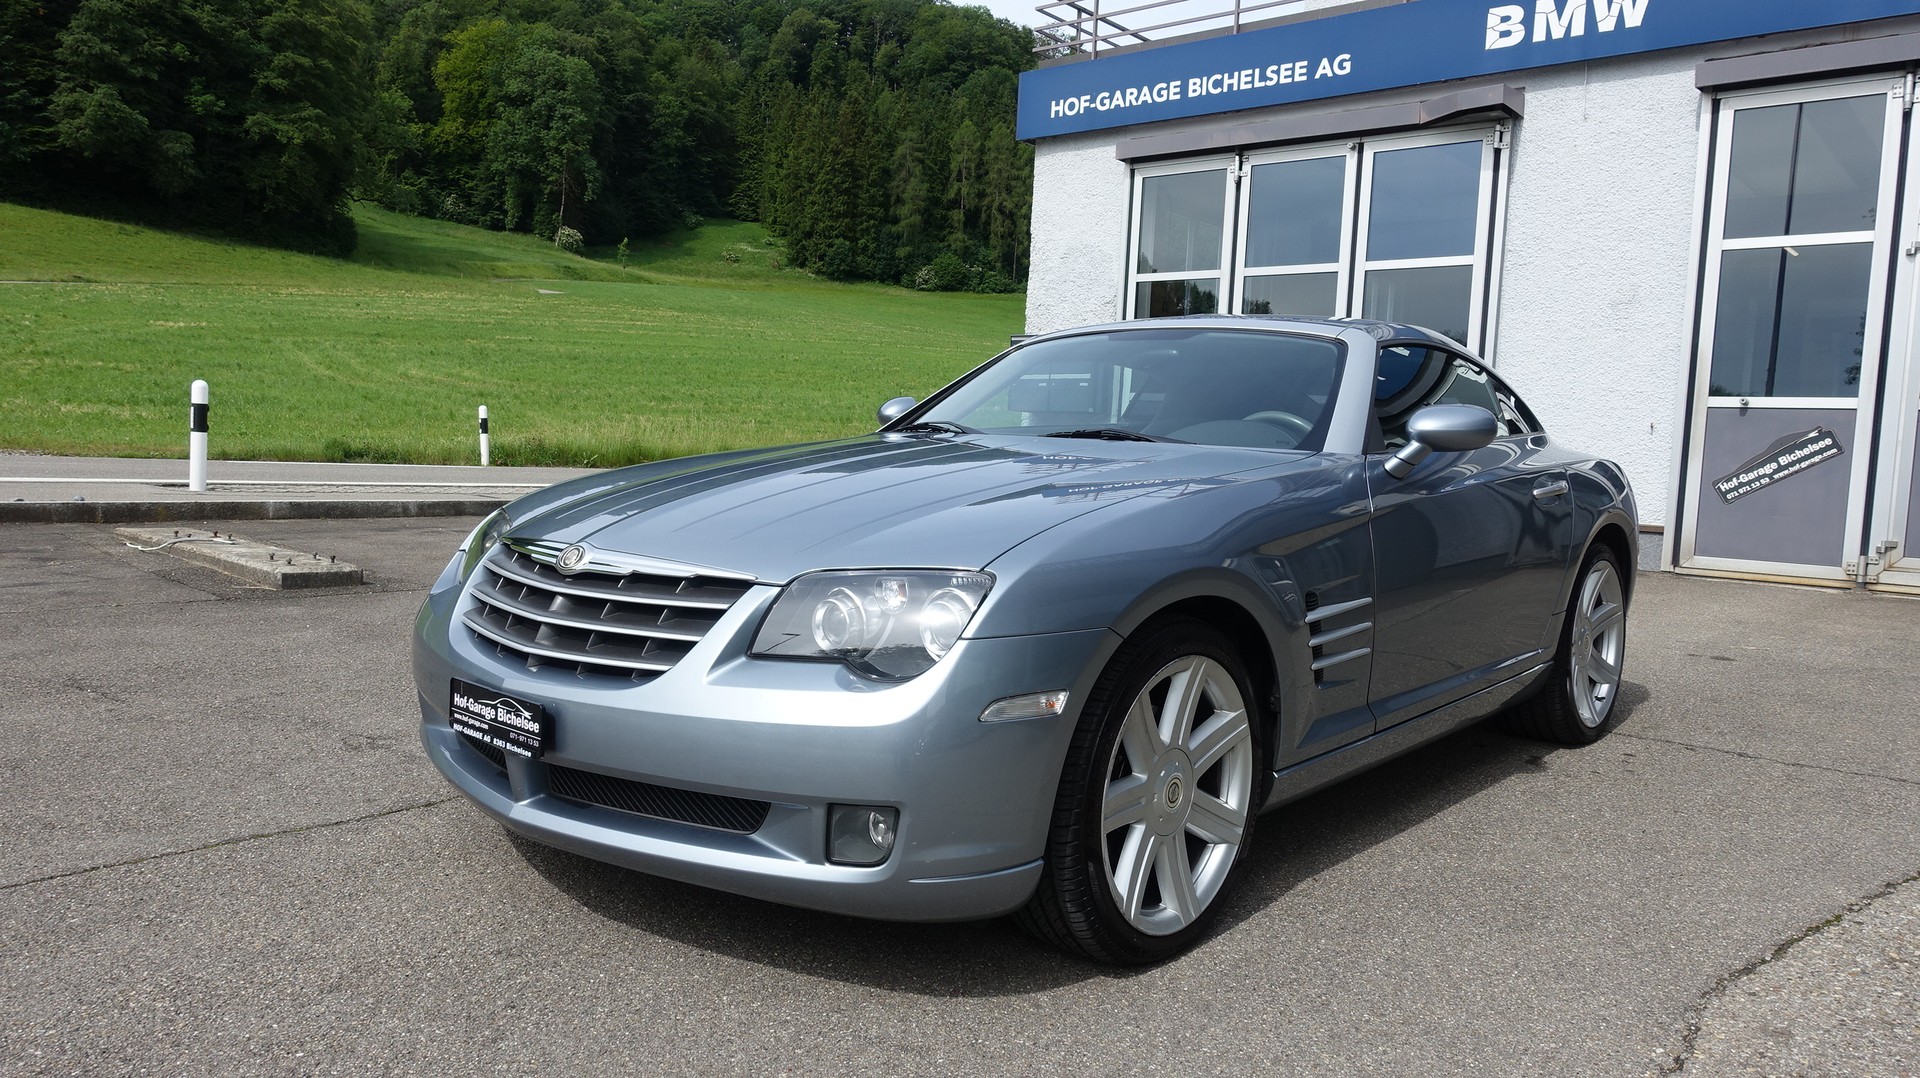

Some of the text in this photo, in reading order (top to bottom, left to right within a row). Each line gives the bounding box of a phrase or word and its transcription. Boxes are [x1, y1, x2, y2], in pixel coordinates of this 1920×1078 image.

[1485, 0, 1649, 50] BMW
[1050, 53, 1352, 118] HOF-GARAGE BICHELSEE AG
[1719, 437, 1833, 492] Hof-Garage Bichelsee
[1773, 448, 1838, 479] www.hof-garage.com
[454, 692, 540, 733] Hof-Garage Bichelsee
[454, 713, 489, 730] www.hof-garage.com
[453, 723, 483, 740] HOF-GARAGE
[483, 733, 491, 743] AG
[506, 742, 532, 758] Bichelsee
